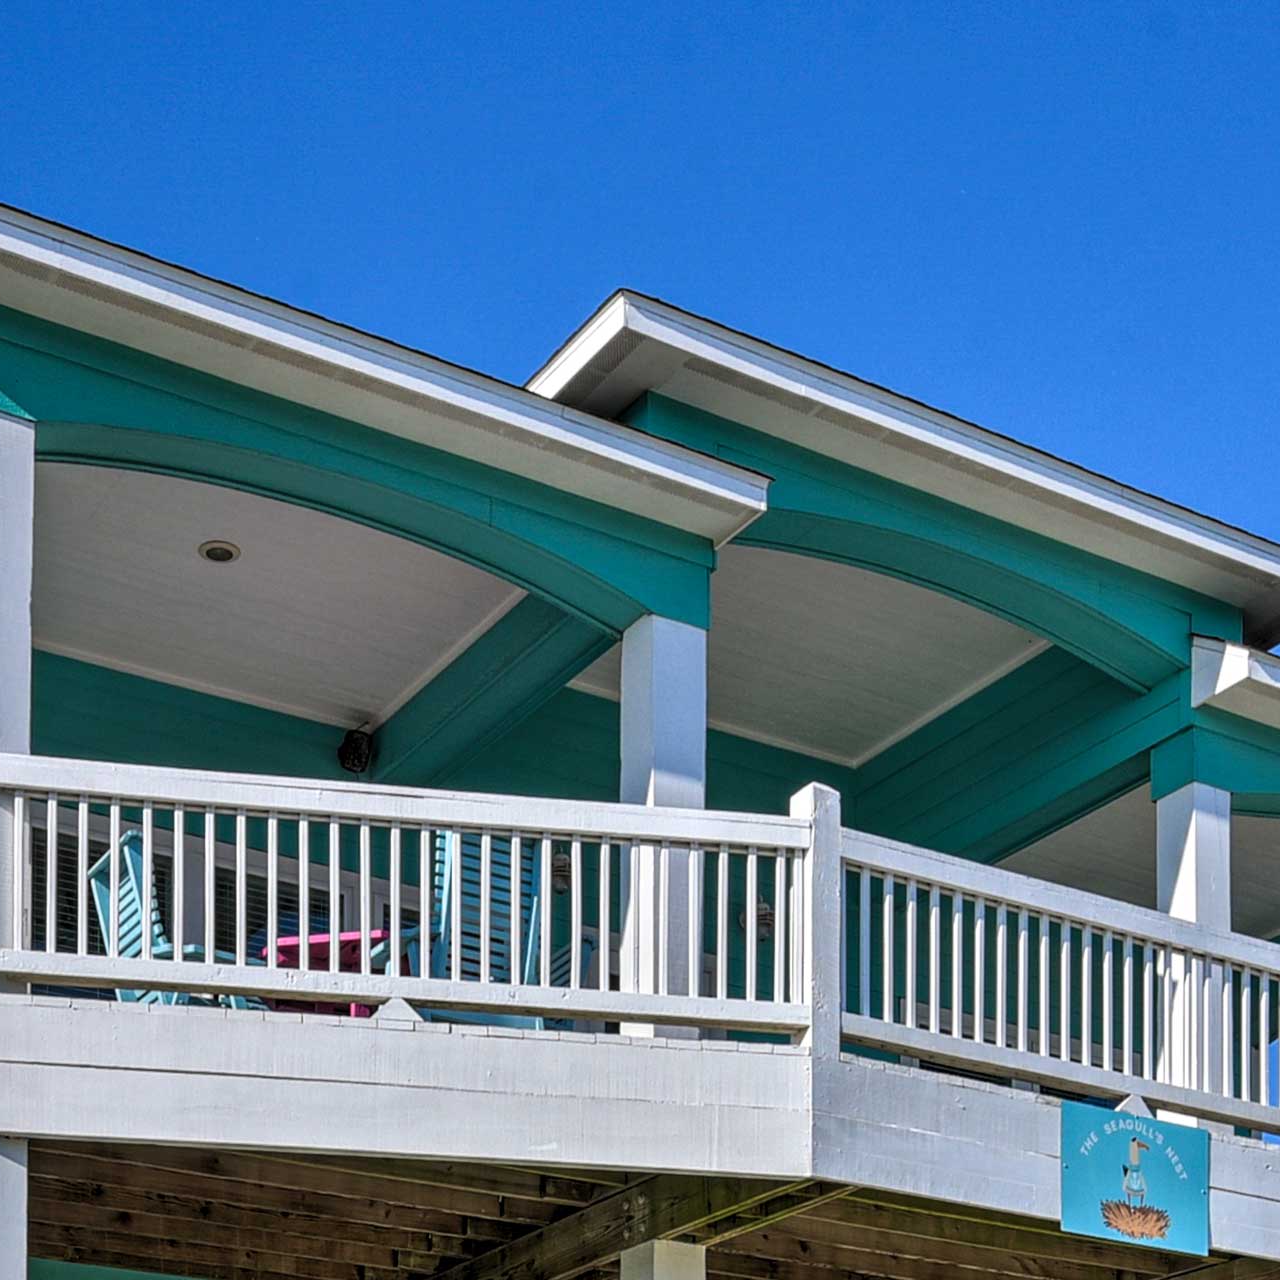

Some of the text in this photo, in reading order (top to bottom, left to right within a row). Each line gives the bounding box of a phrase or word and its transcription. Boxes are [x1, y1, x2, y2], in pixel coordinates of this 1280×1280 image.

[1080, 1119, 1188, 1181] THE SEAGULL'S NEST
